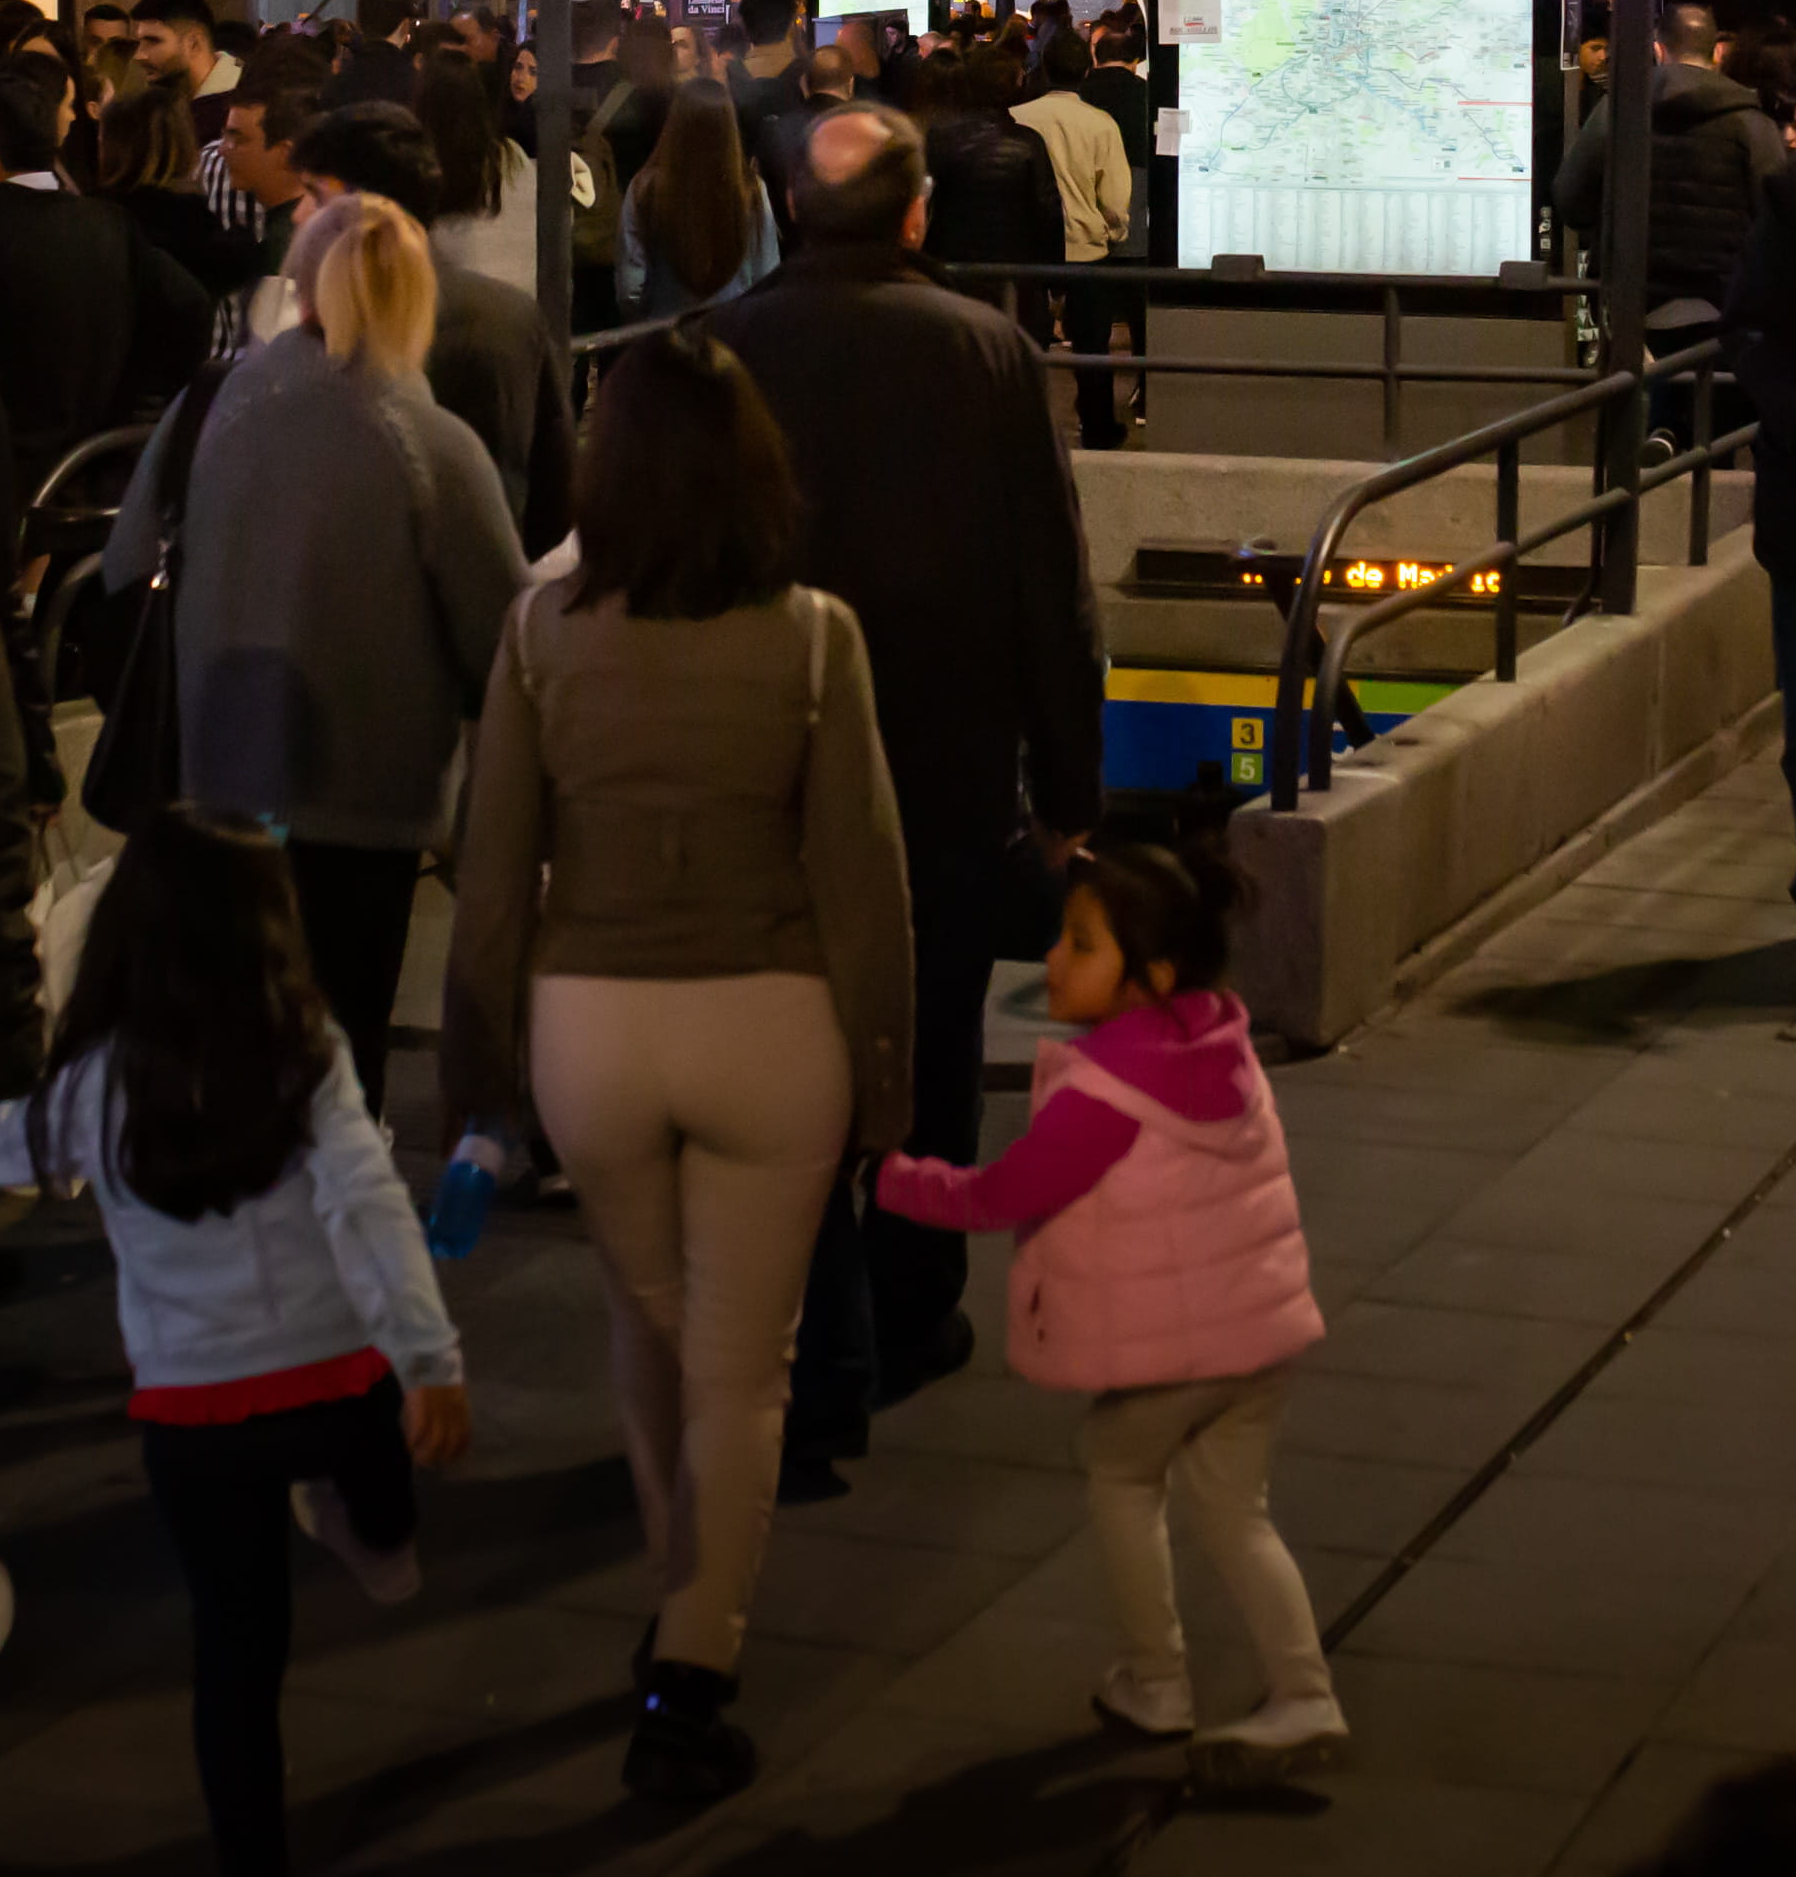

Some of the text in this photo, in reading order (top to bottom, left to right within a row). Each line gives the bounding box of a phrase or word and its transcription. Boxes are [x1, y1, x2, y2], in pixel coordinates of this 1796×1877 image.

[1346, 561, 1385, 589] de
[1240, 723, 1255, 744] 3
[1239, 757, 1255, 781] 5
